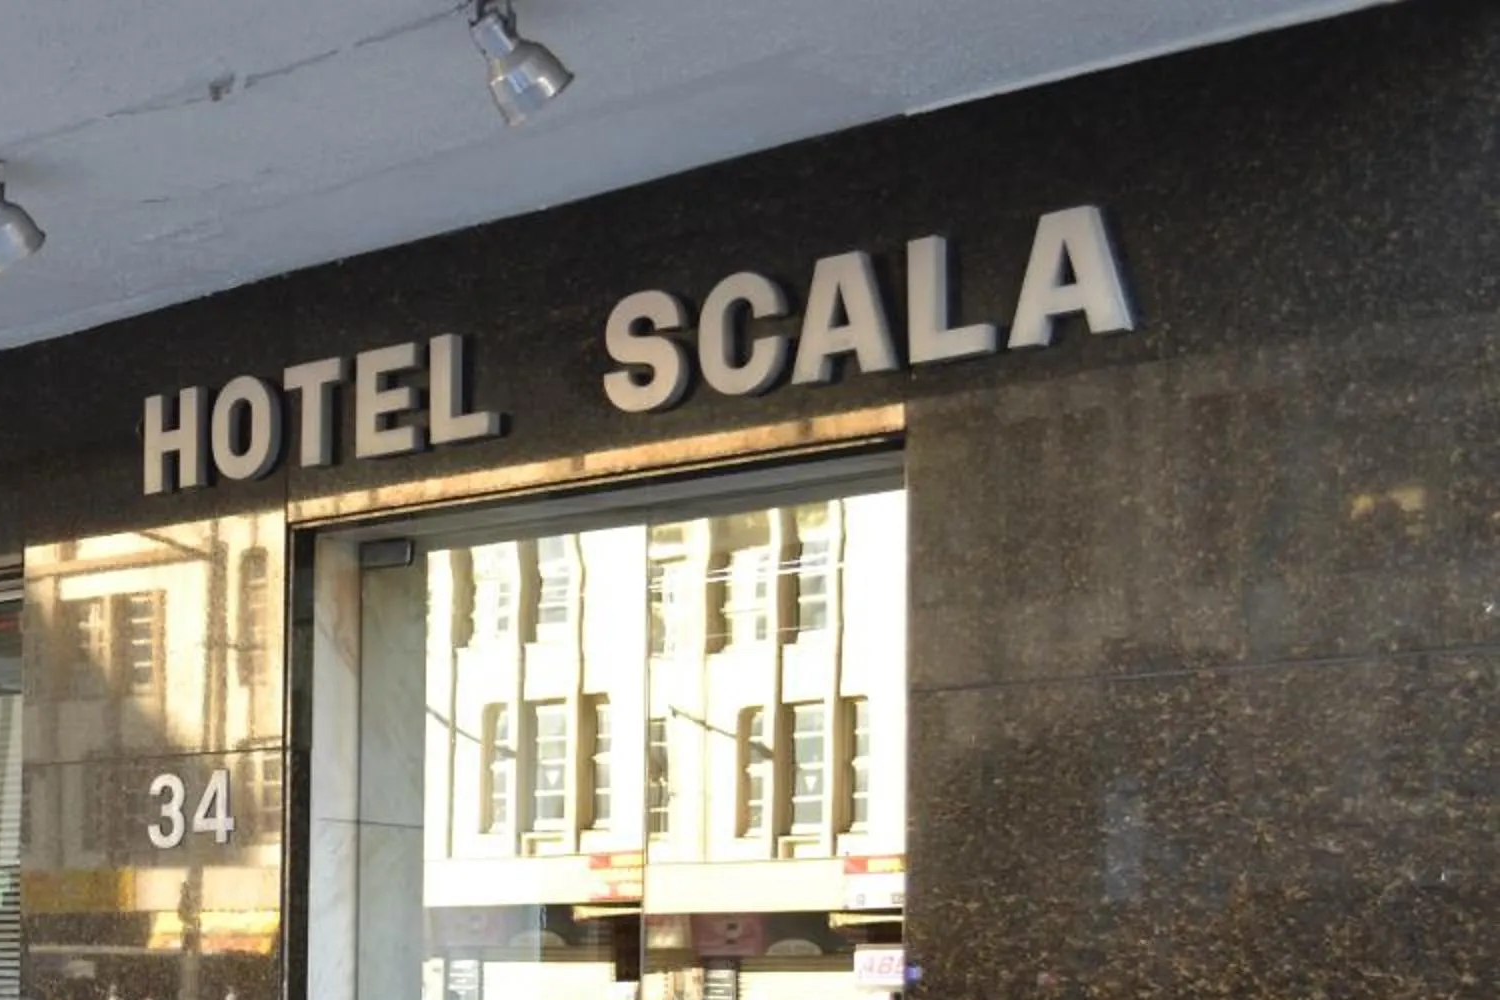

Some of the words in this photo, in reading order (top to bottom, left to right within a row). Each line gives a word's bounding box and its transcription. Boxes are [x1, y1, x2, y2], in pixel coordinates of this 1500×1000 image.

[143, 333, 500, 496] HOTEL
[603, 205, 1134, 413] SCALA
[147, 769, 235, 849] 34
